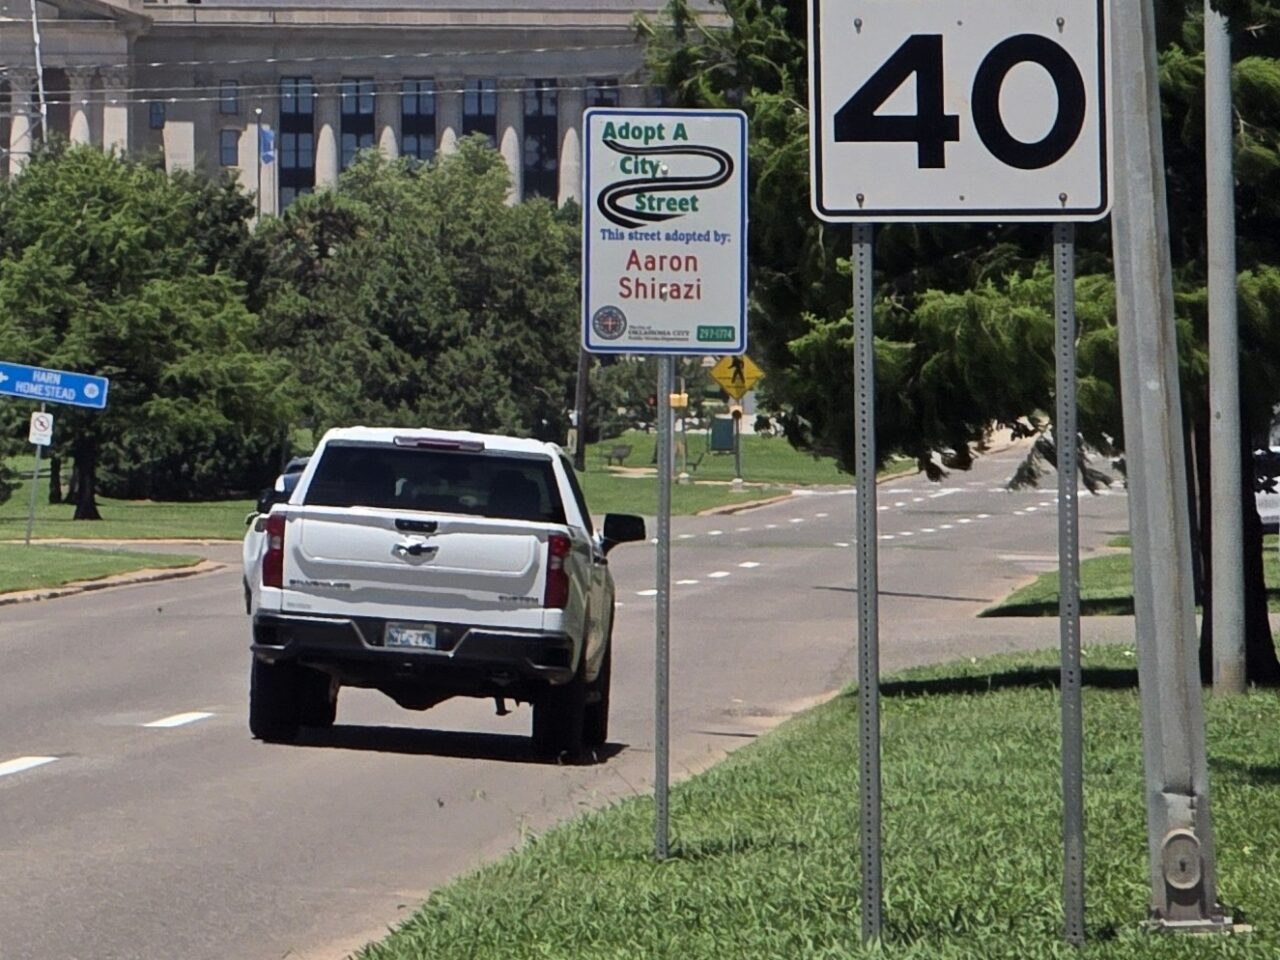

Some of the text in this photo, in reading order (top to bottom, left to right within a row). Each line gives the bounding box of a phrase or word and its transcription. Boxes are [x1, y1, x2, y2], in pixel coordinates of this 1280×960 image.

[833, 33, 1086, 170] 40
[602, 121, 688, 145] Adopt A
[620, 155, 660, 179] City
[635, 193, 699, 212] Street
[600, 228, 731, 245] This street adopted by:
[625, 249, 698, 272] Aaron
[619, 276, 701, 301] Shirazi
[32, 370, 61, 385] HARN
[15, 381, 77, 401] HOMESTEAD
